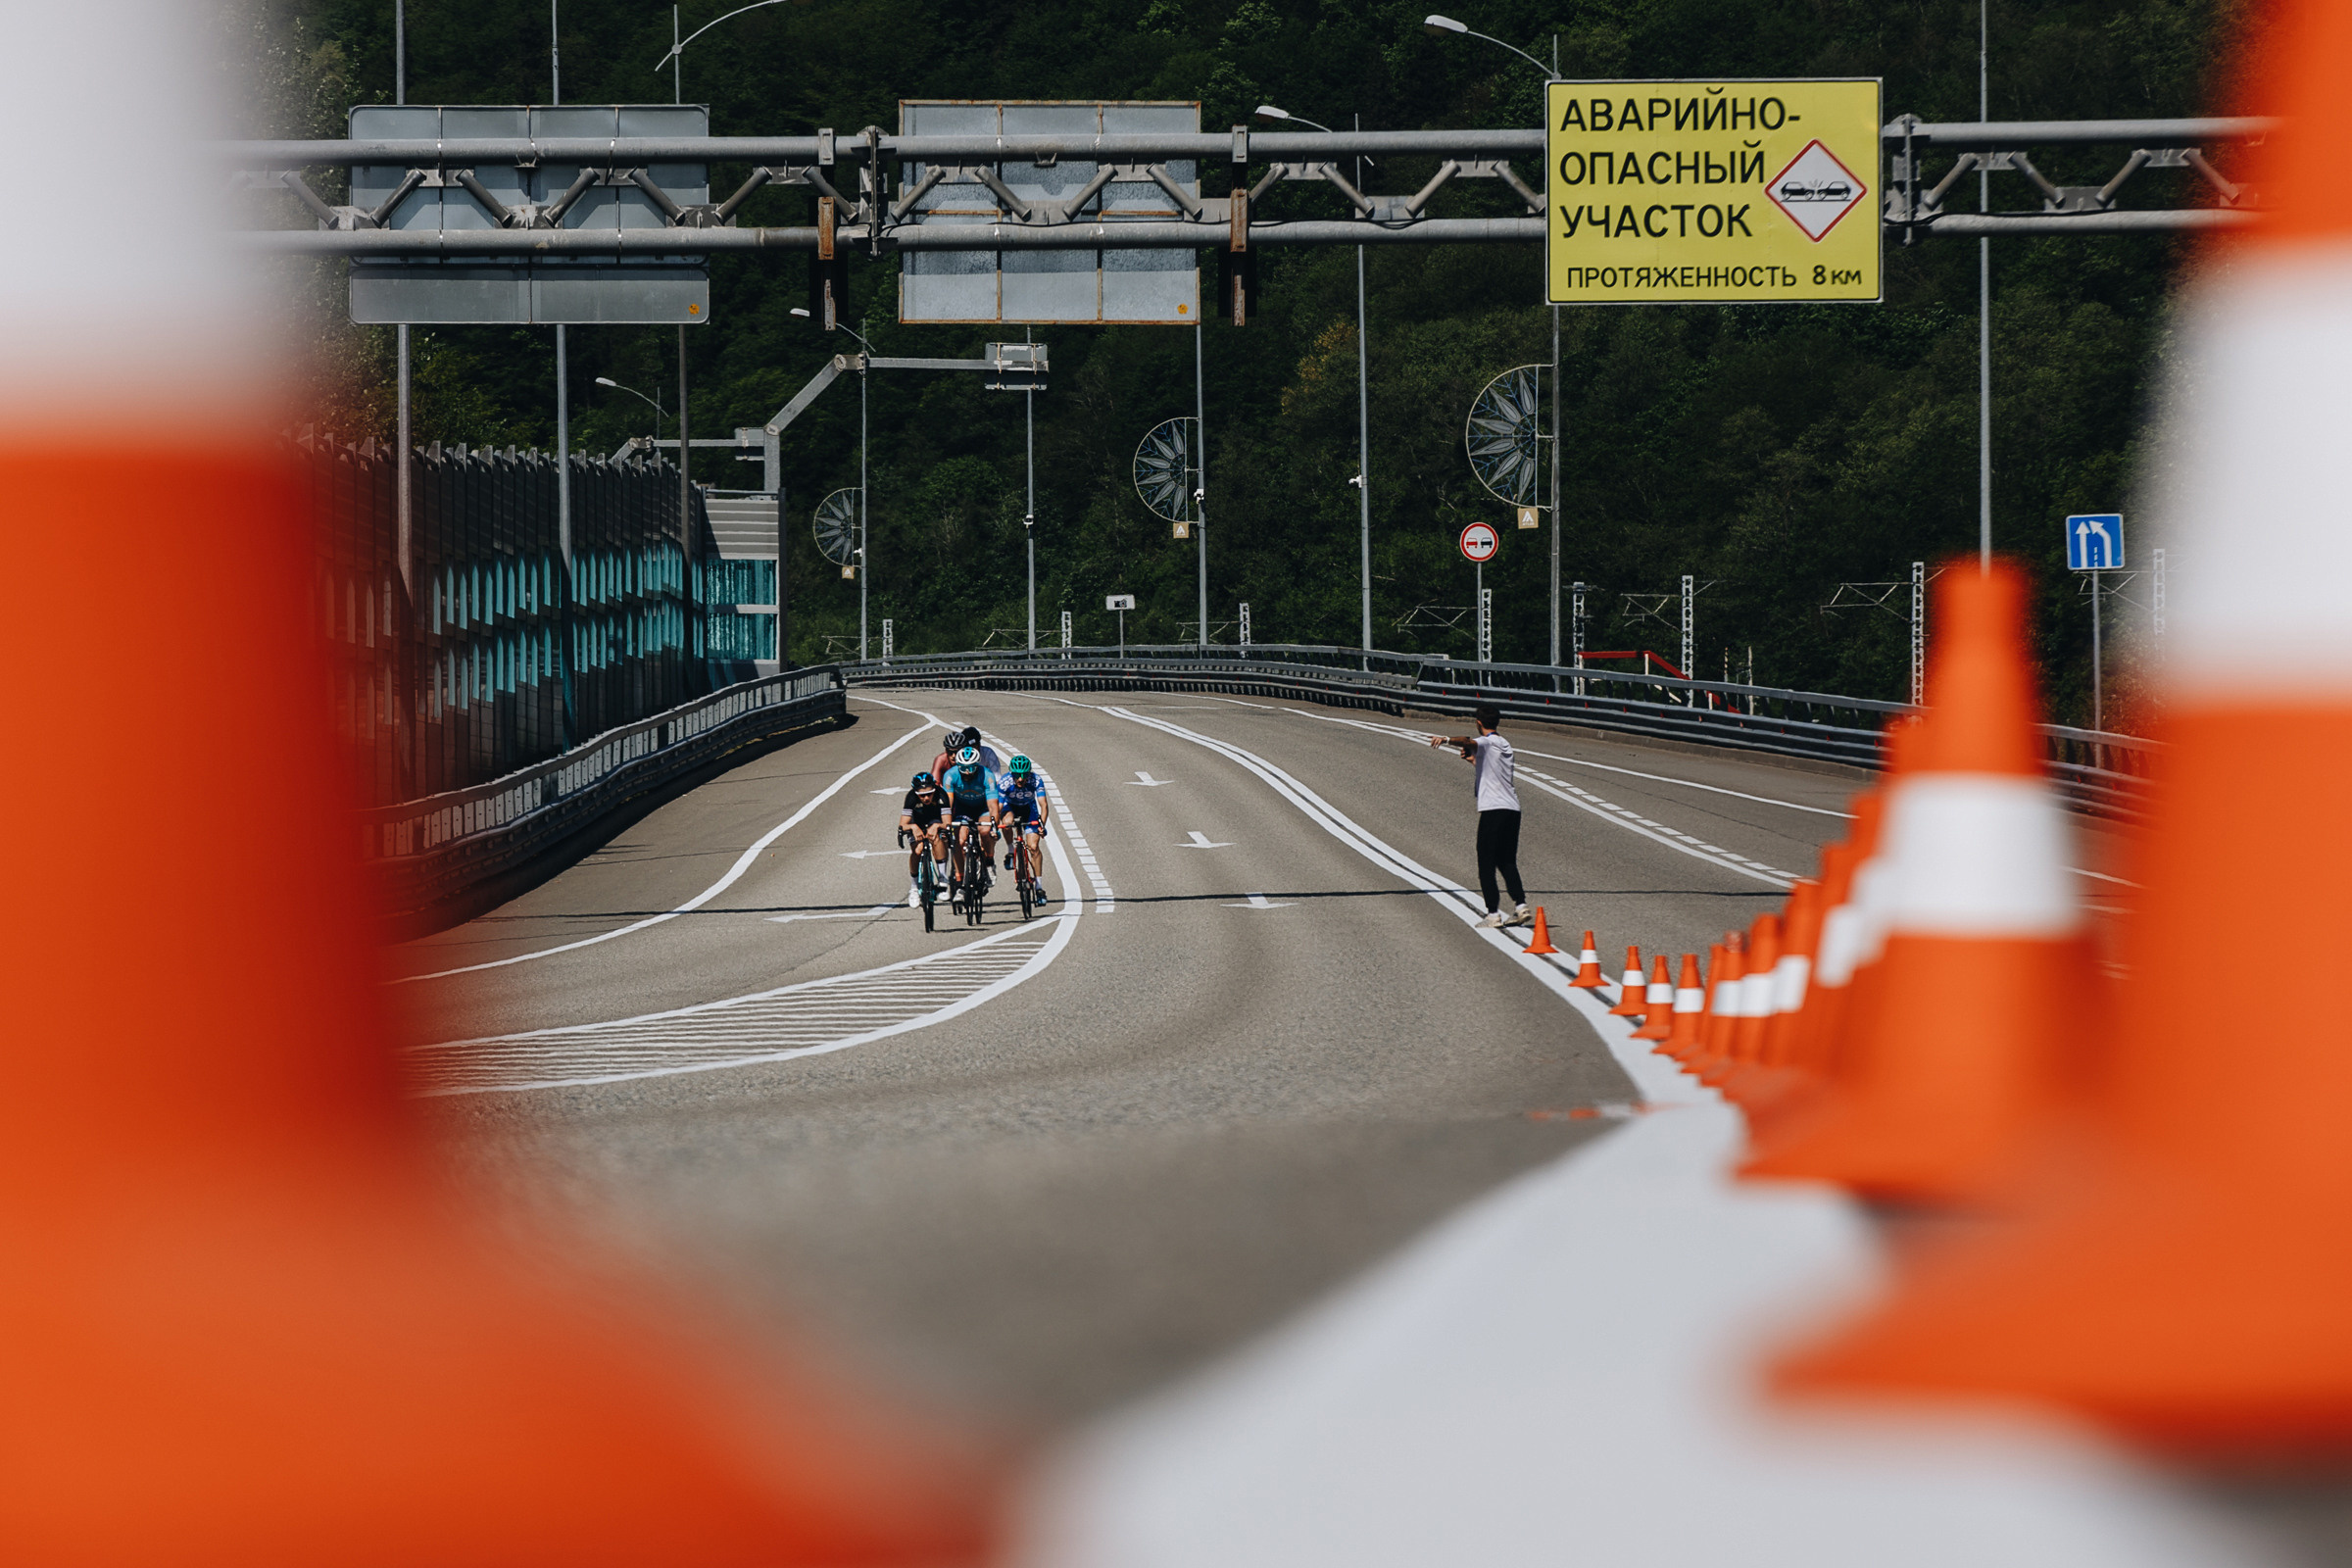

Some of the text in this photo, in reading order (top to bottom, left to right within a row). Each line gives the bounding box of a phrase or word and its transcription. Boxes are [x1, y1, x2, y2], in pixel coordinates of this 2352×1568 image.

[1560, 86, 1801, 132] АВАРИЙНО-
[1559, 139, 1765, 186] ОПАСНЫЙ
[1559, 203, 1753, 239] УЧАСТОК
[1567, 266, 1797, 289] ПРОТЯЖЕННОСТЬ
[1812, 264, 1827, 286] 8
